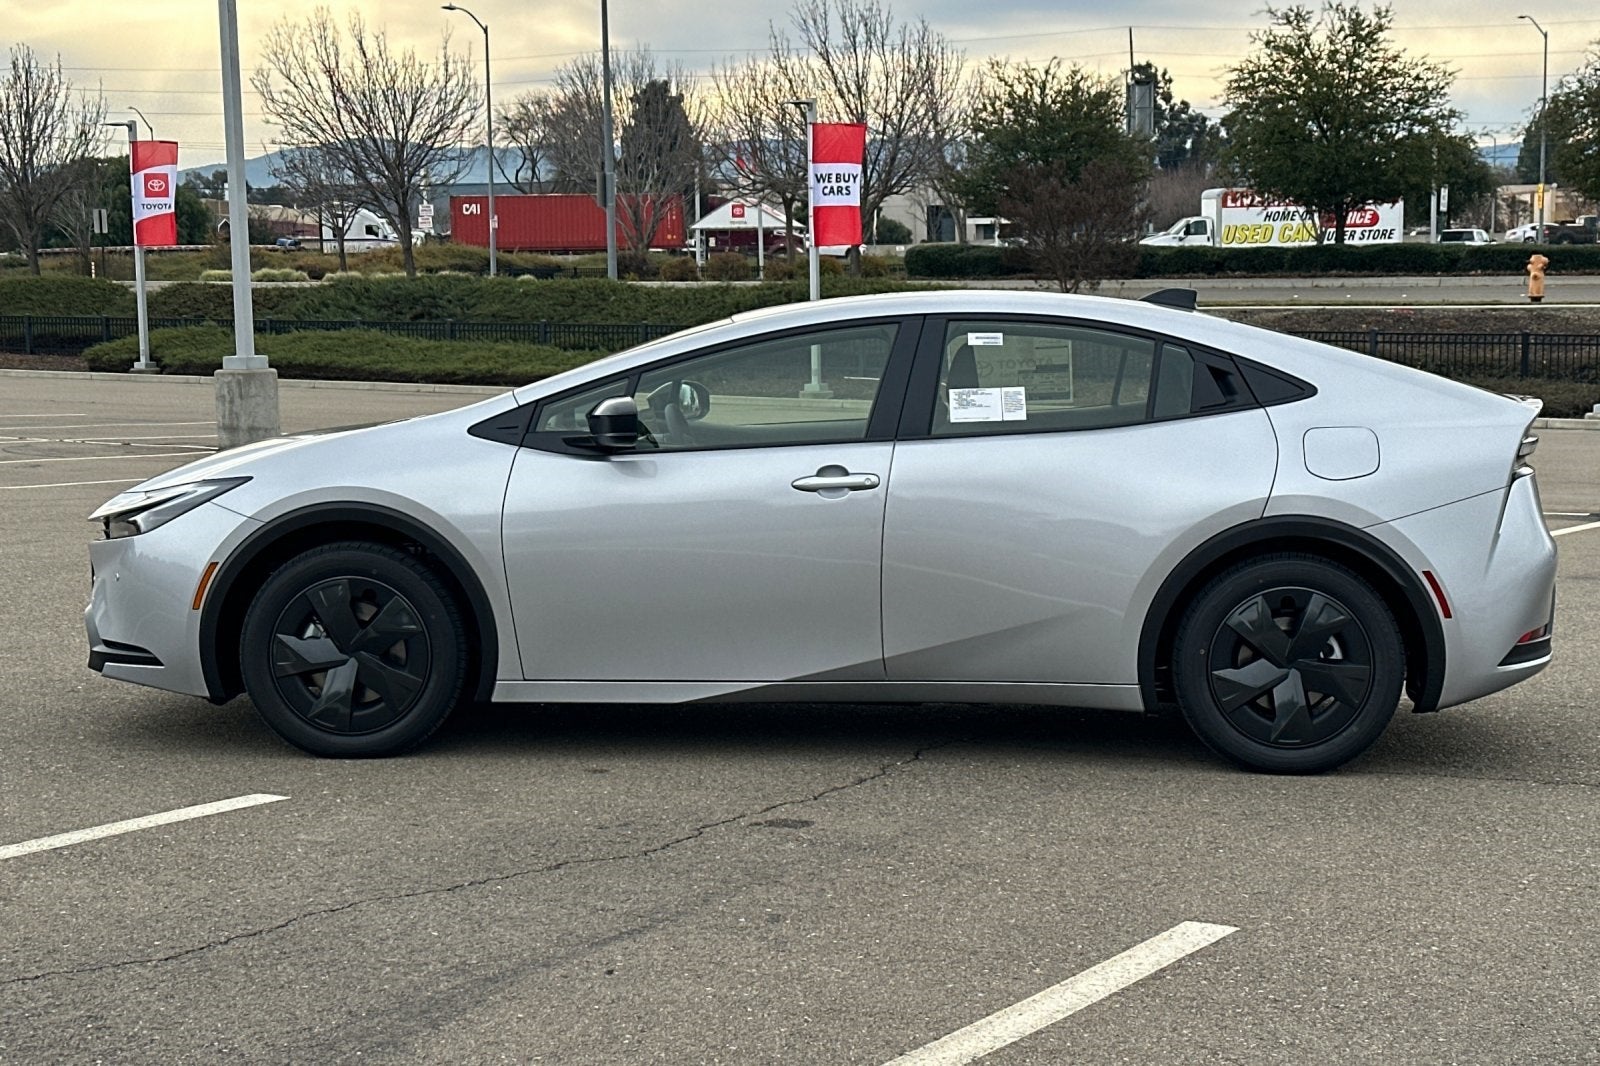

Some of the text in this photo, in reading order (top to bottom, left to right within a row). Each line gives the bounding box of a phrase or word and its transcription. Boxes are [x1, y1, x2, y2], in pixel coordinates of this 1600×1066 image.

[815, 173, 858, 183] WE BUY
[822, 186, 851, 196] CARS
[463, 204, 480, 215] CAI
[1264, 210, 1298, 222] HOME
[1222, 224, 1274, 244] USED
[1359, 228, 1396, 240] STORE
